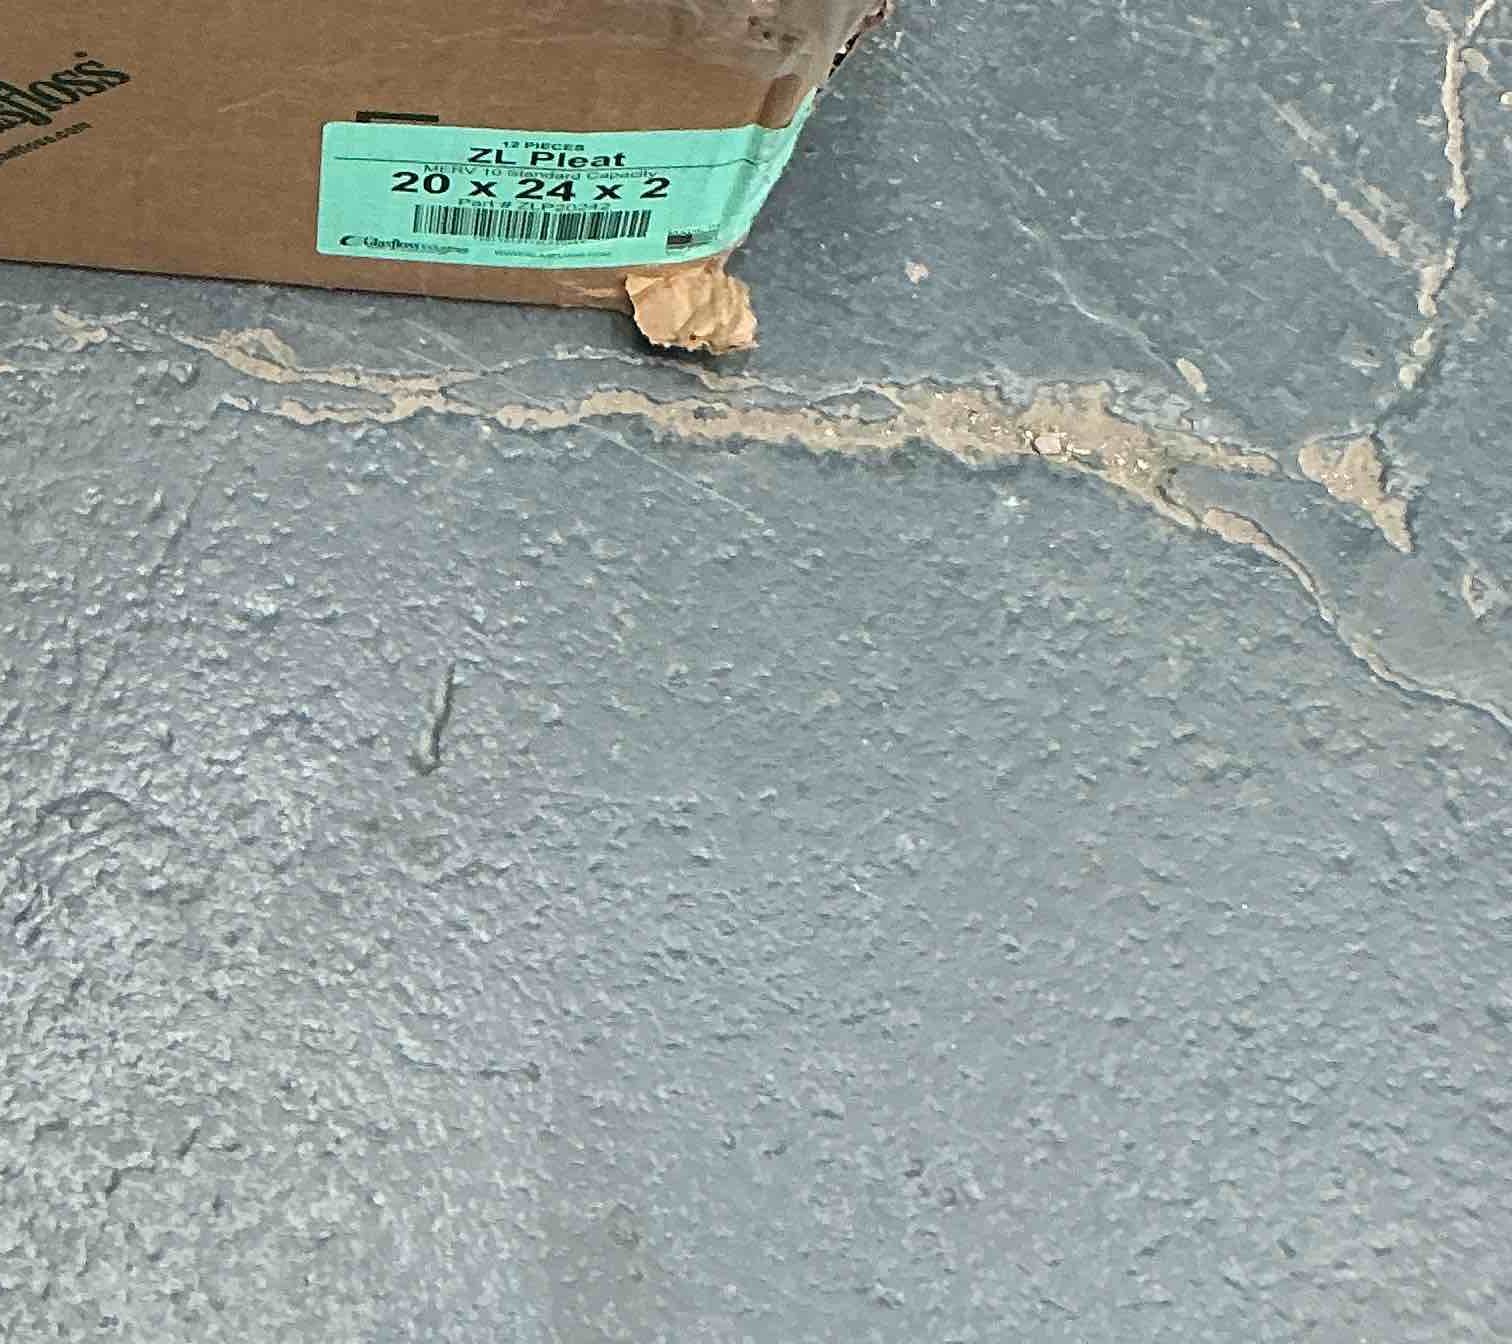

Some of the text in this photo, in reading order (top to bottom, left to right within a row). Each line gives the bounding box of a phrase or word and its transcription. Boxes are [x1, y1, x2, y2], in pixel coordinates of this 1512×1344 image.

[524, 141, 586, 152] PIECES
[467, 147, 627, 168] ZL Pleat
[423, 164, 478, 176] MERV
[507, 168, 581, 181] Standard
[587, 170, 658, 182] Capacity
[391, 171, 671, 203] 20 x 24 x 2
